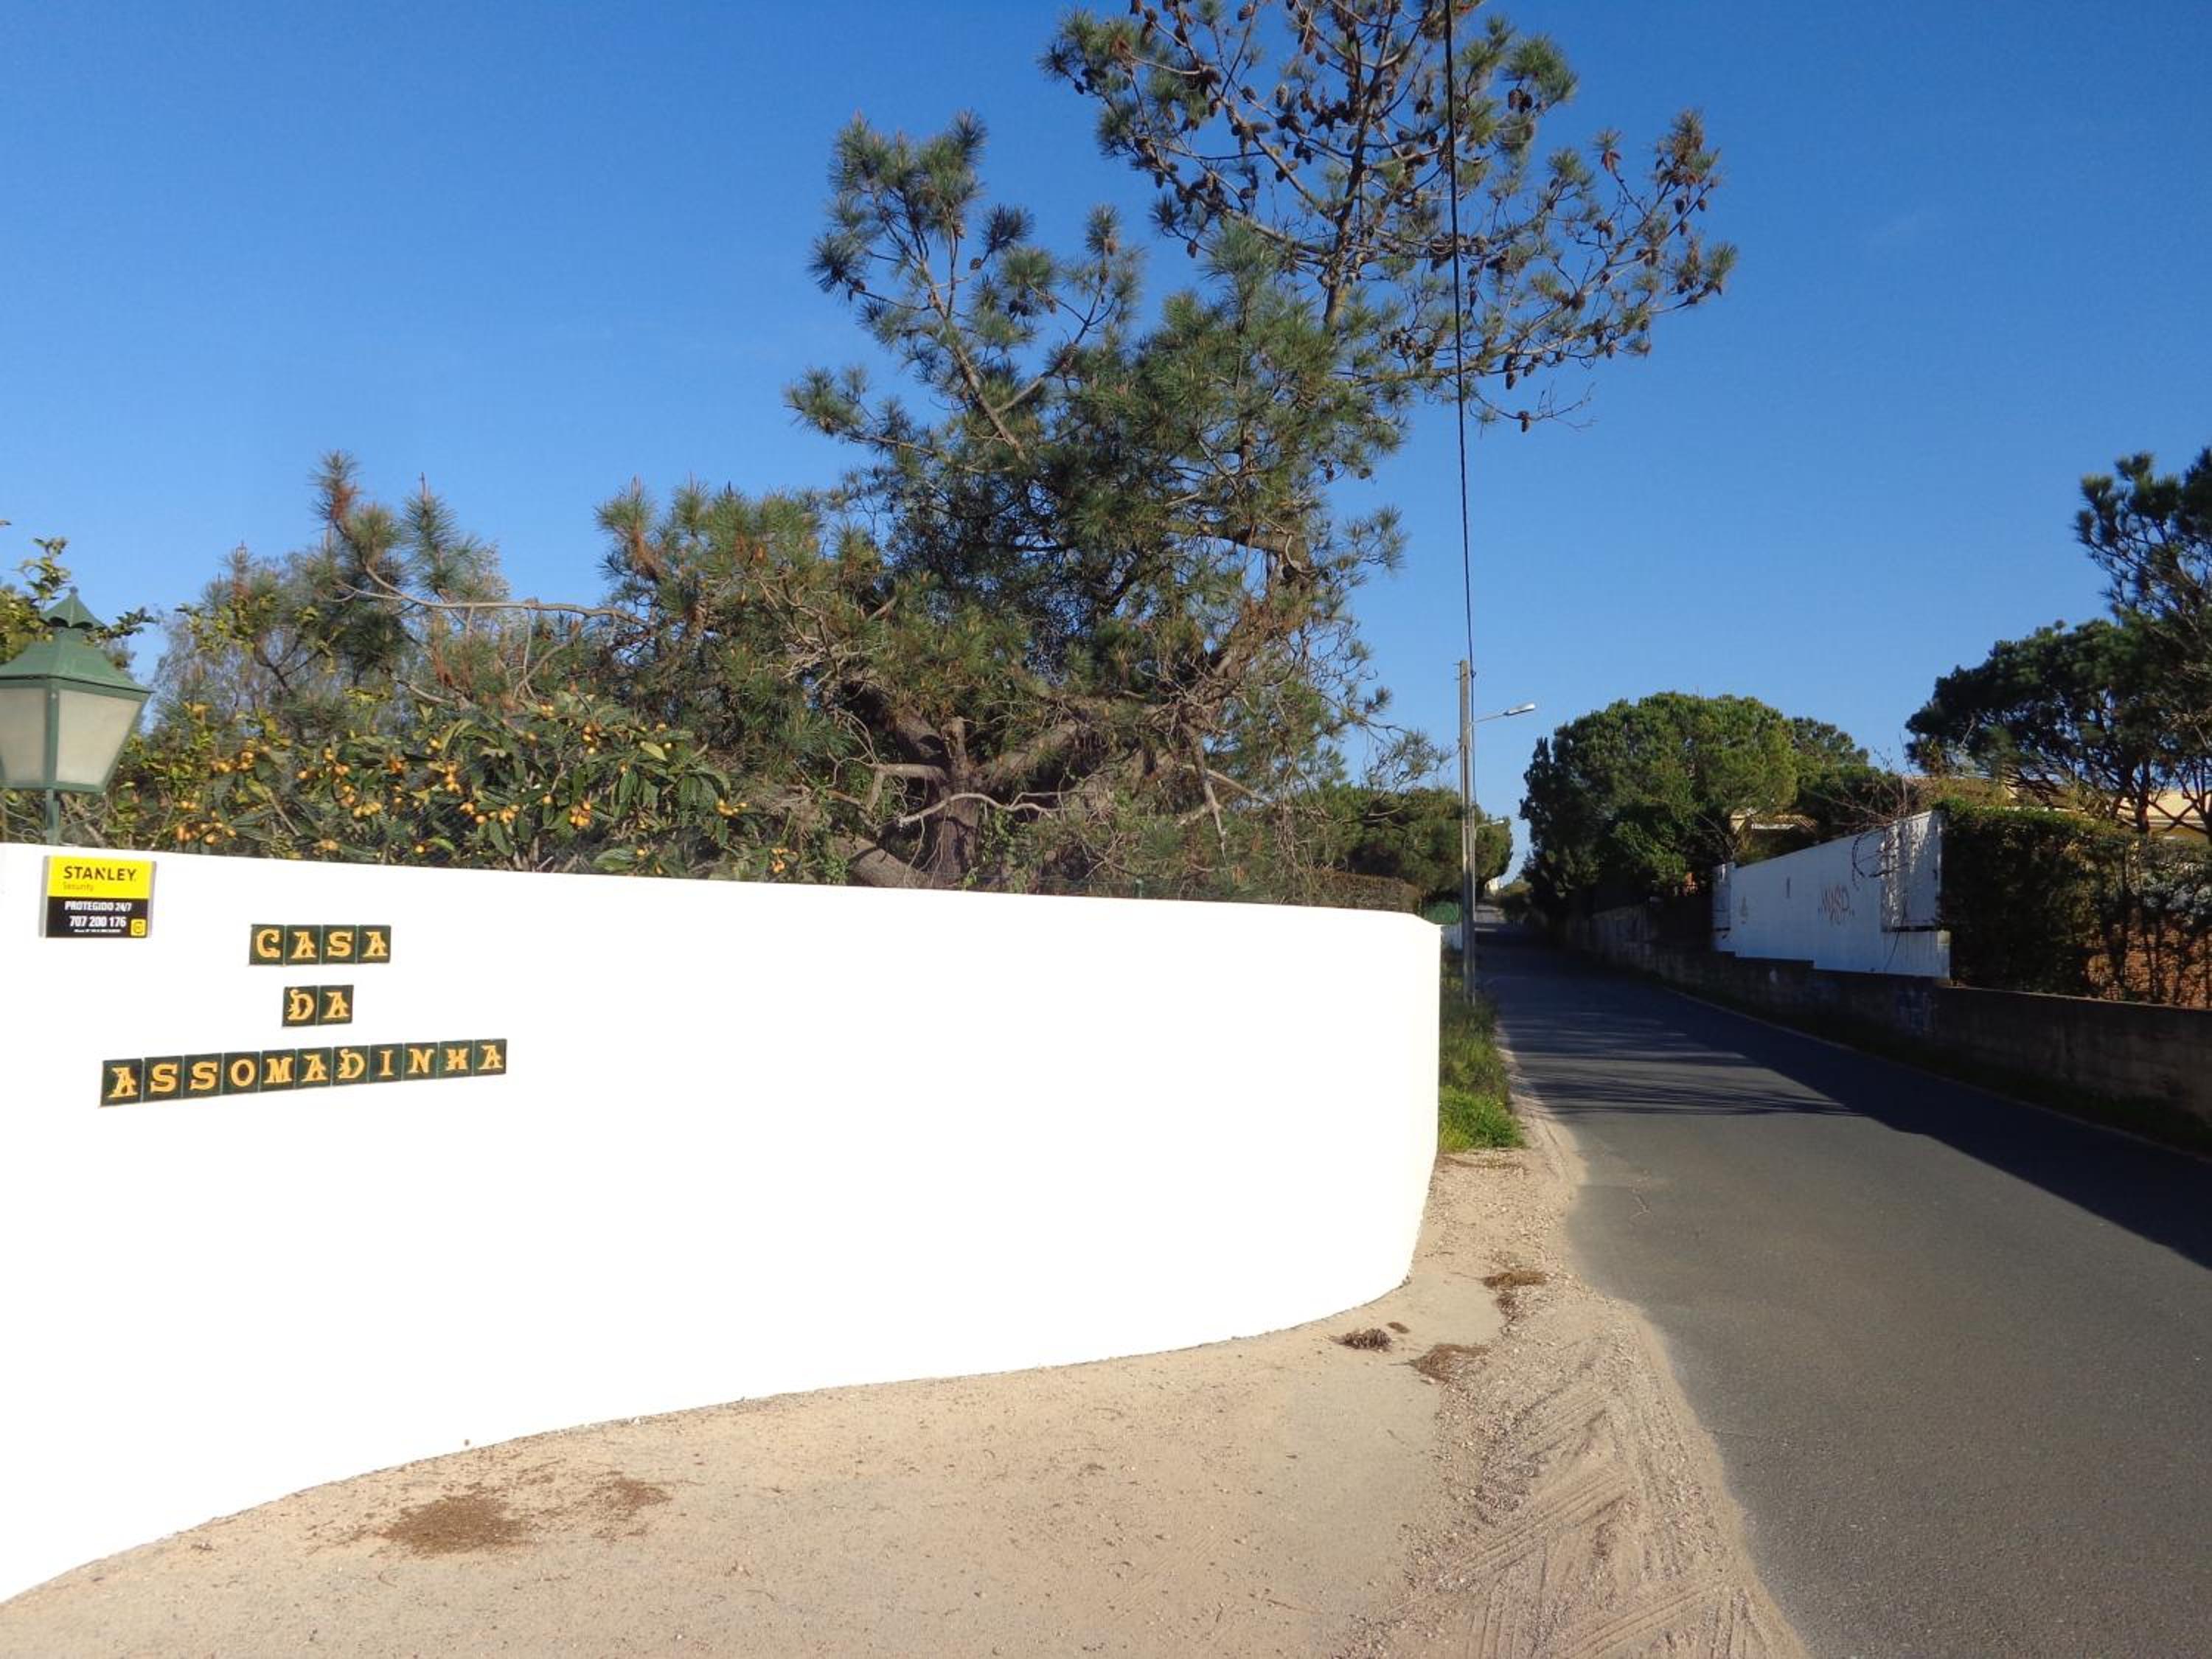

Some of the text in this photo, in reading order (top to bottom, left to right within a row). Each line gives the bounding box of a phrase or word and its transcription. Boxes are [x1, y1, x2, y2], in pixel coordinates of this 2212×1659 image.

[63, 866, 136, 881] STANLEY
[64, 900, 132, 912] PROTEGIDO 24/7
[69, 915, 127, 928] 707 200 176
[255, 928, 389, 960] CASA
[287, 989, 352, 1021] DA
[107, 1043, 504, 1099] ASSOMADINHA
